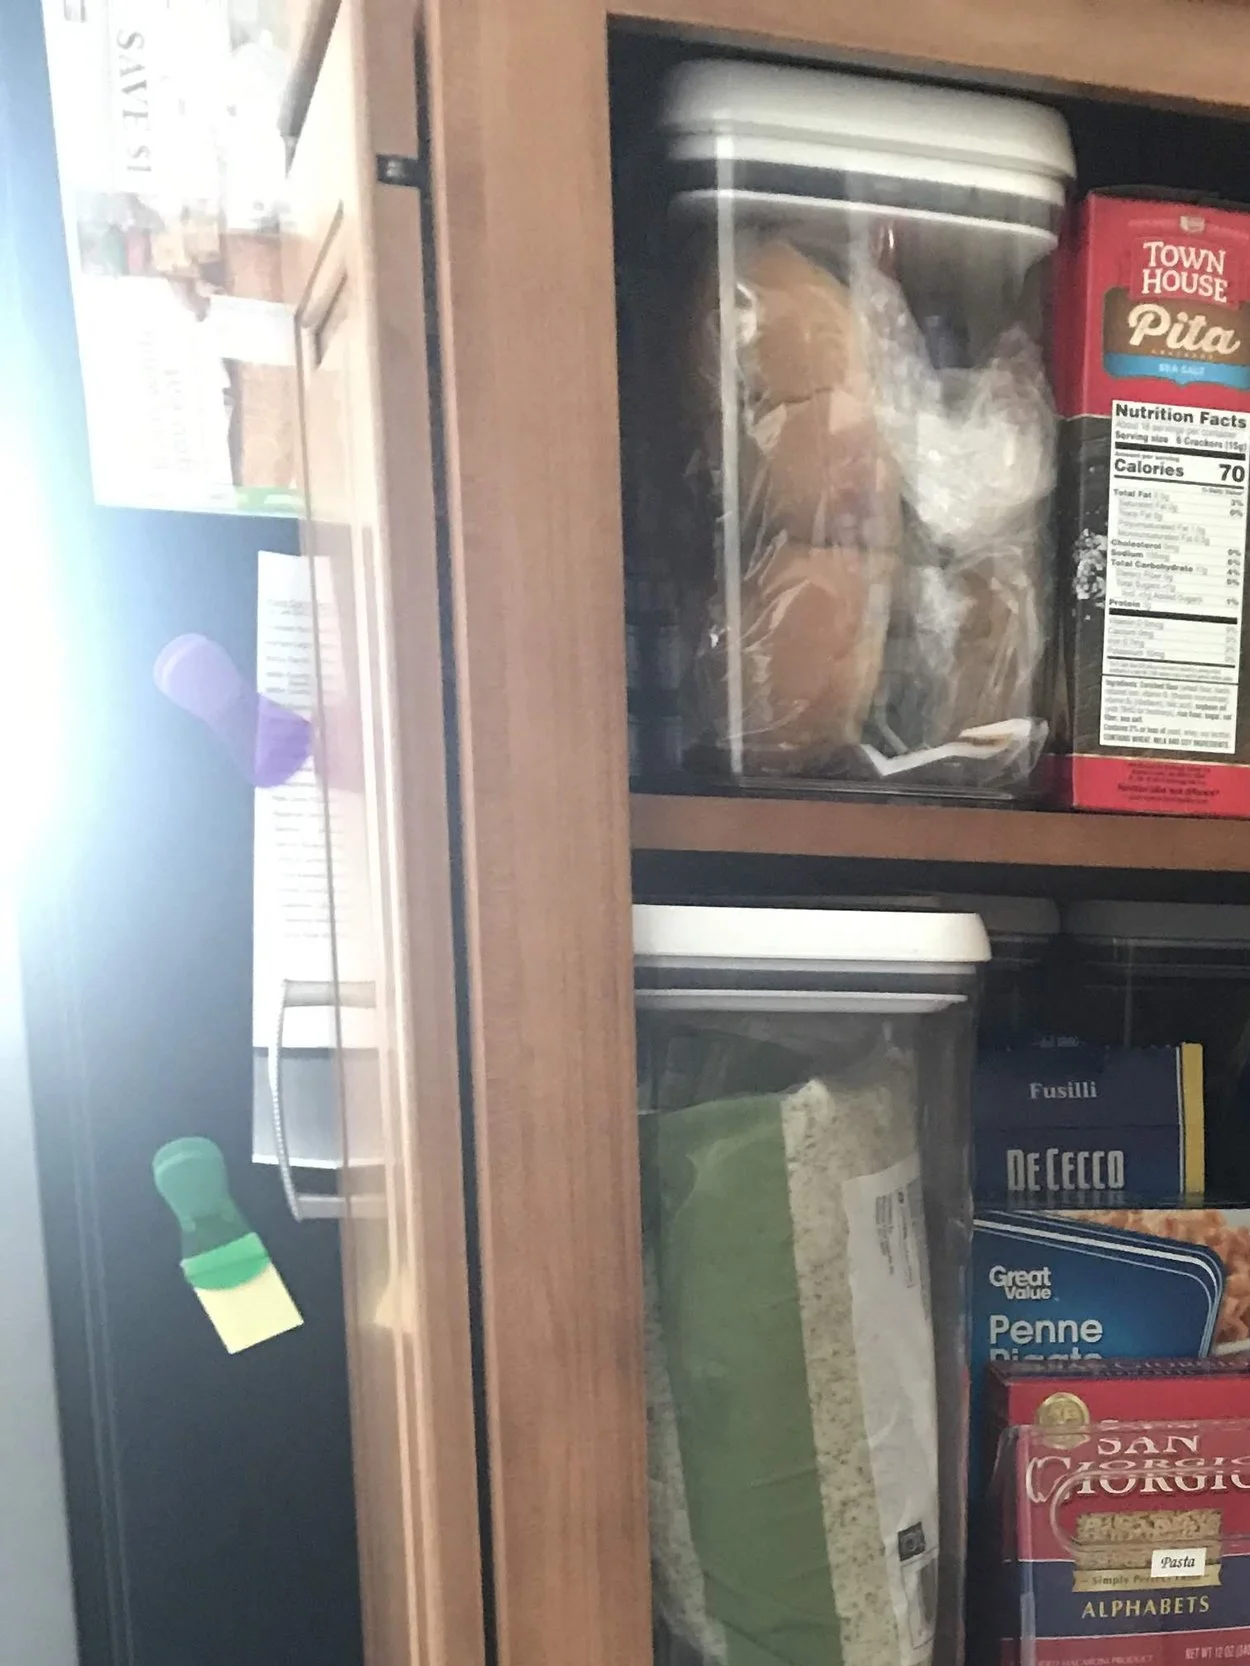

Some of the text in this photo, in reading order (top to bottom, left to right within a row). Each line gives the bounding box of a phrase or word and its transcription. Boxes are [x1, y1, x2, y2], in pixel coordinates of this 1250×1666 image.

[1142, 240, 1227, 275] TOWN
[1141, 268, 1228, 303] HOUSE
[1127, 303, 1241, 355] Pita
[1115, 403, 1247, 429] Nutrition Facts
[1115, 430, 1148, 443] Serving
[1151, 434, 1169, 443] size
[1184, 437, 1223, 449] Crackers
[1114, 458, 1246, 483] Calories 70
[1113, 488, 1152, 499] Total Fat
[1111, 538, 1162, 550] Cholesterol
[1111, 558, 1133, 568] Total
[1135, 560, 1194, 574] Carbohydrate
[1030, 1080, 1098, 1100] Fusilli
[1007, 1147, 1125, 1192] DE CECCO
[989, 1265, 1052, 1287] Great
[1004, 1286, 1052, 1300] Value
[989, 1314, 1103, 1345] Penne
[1097, 1435, 1199, 1455] SAN
[1161, 1555, 1196, 1570] Pasta
[1081, 1595, 1211, 1619] ALPHABETS
